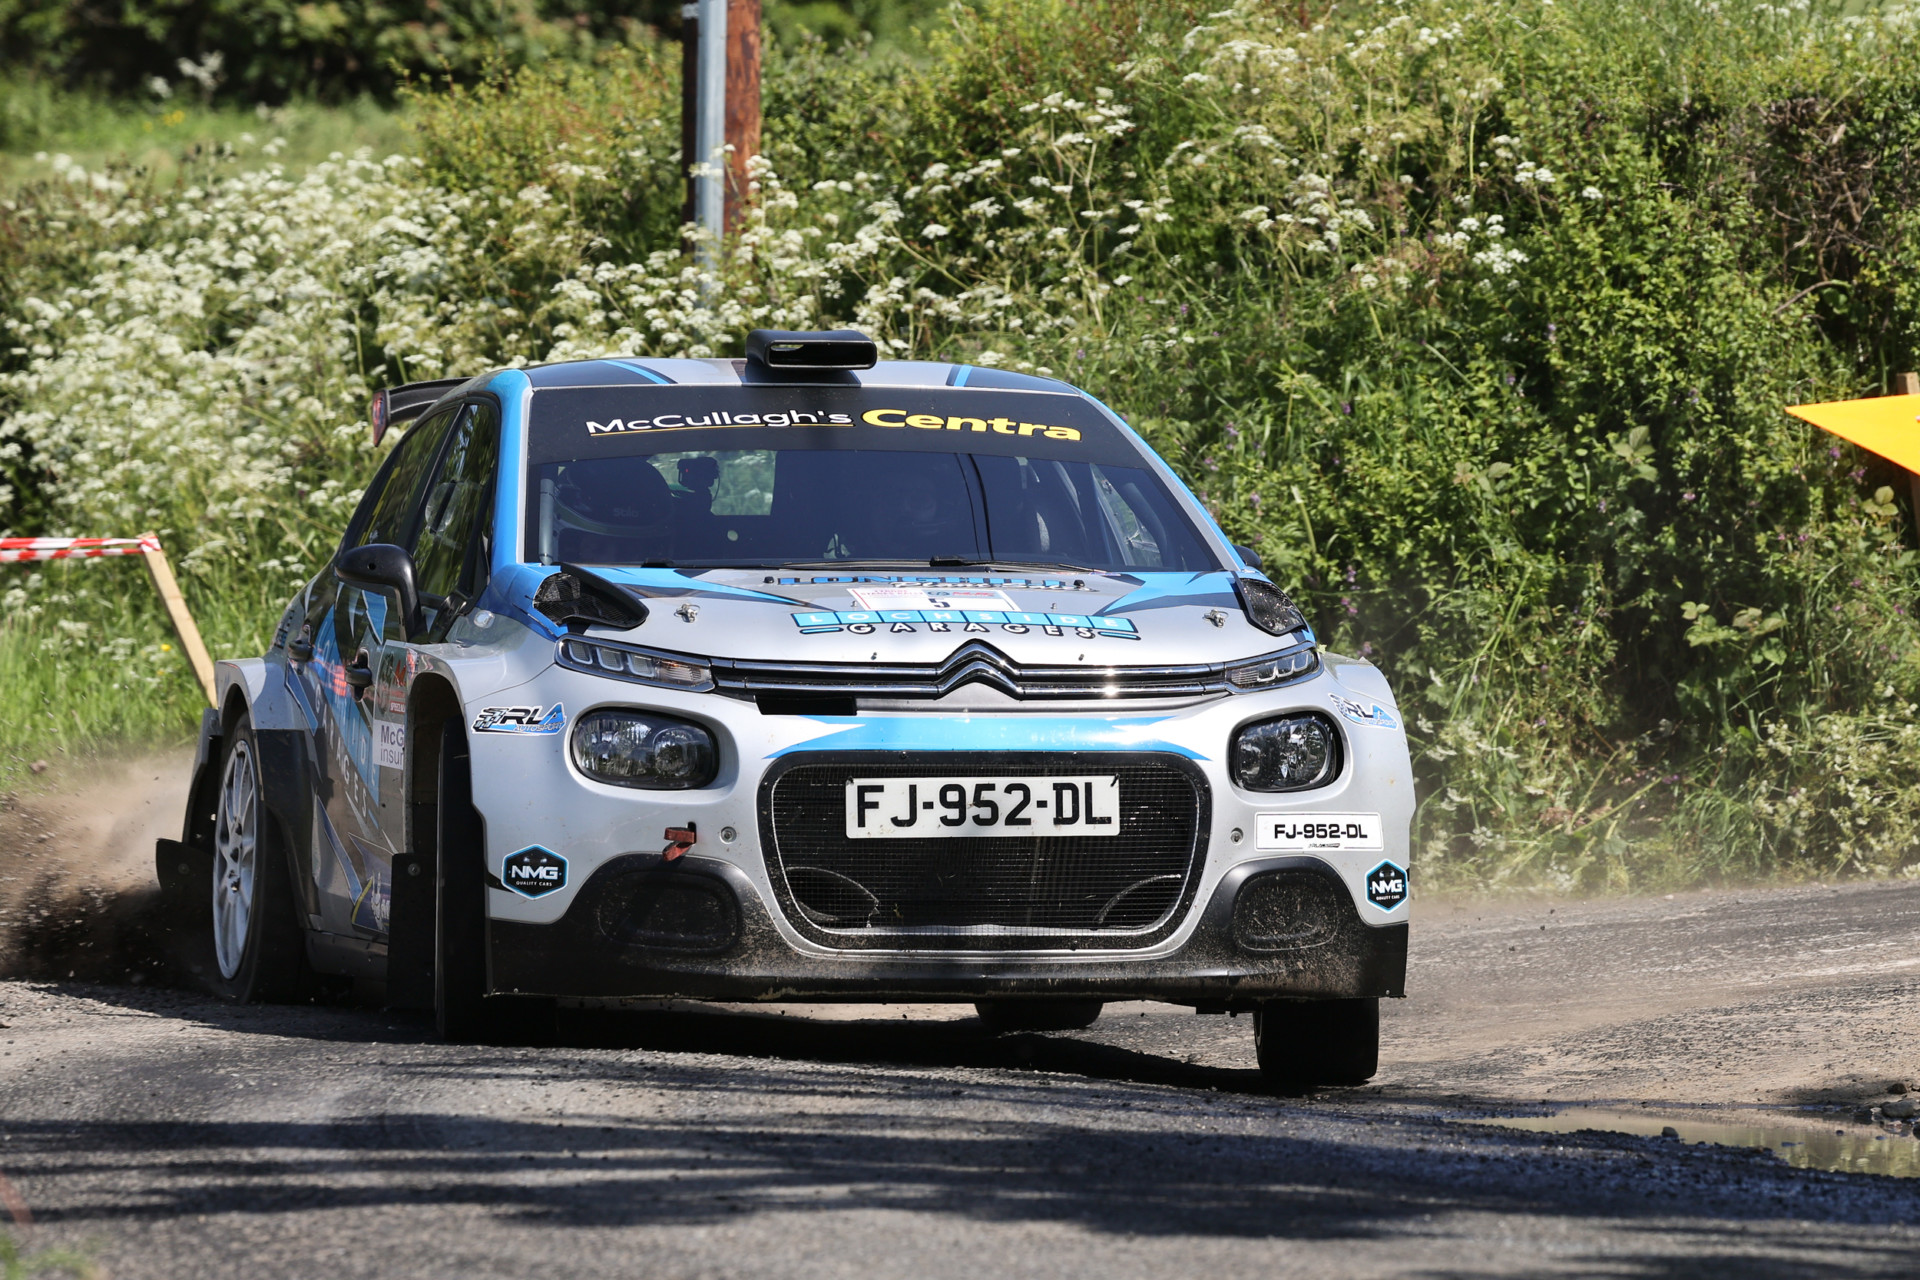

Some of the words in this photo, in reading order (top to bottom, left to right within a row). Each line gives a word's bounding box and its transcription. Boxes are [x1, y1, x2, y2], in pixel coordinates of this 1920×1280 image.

[586, 410, 854, 433] McCullagh's
[862, 409, 1082, 441] Centra
[928, 598, 951, 608] 5
[808, 610, 1120, 629] LOCHSIDE
[847, 622, 1096, 639] GARAGES
[857, 782, 1113, 828] FJ-952-DL
[1274, 823, 1368, 839] FJ-952-DL
[511, 865, 559, 880] NMG
[1371, 878, 1403, 895] NMG
